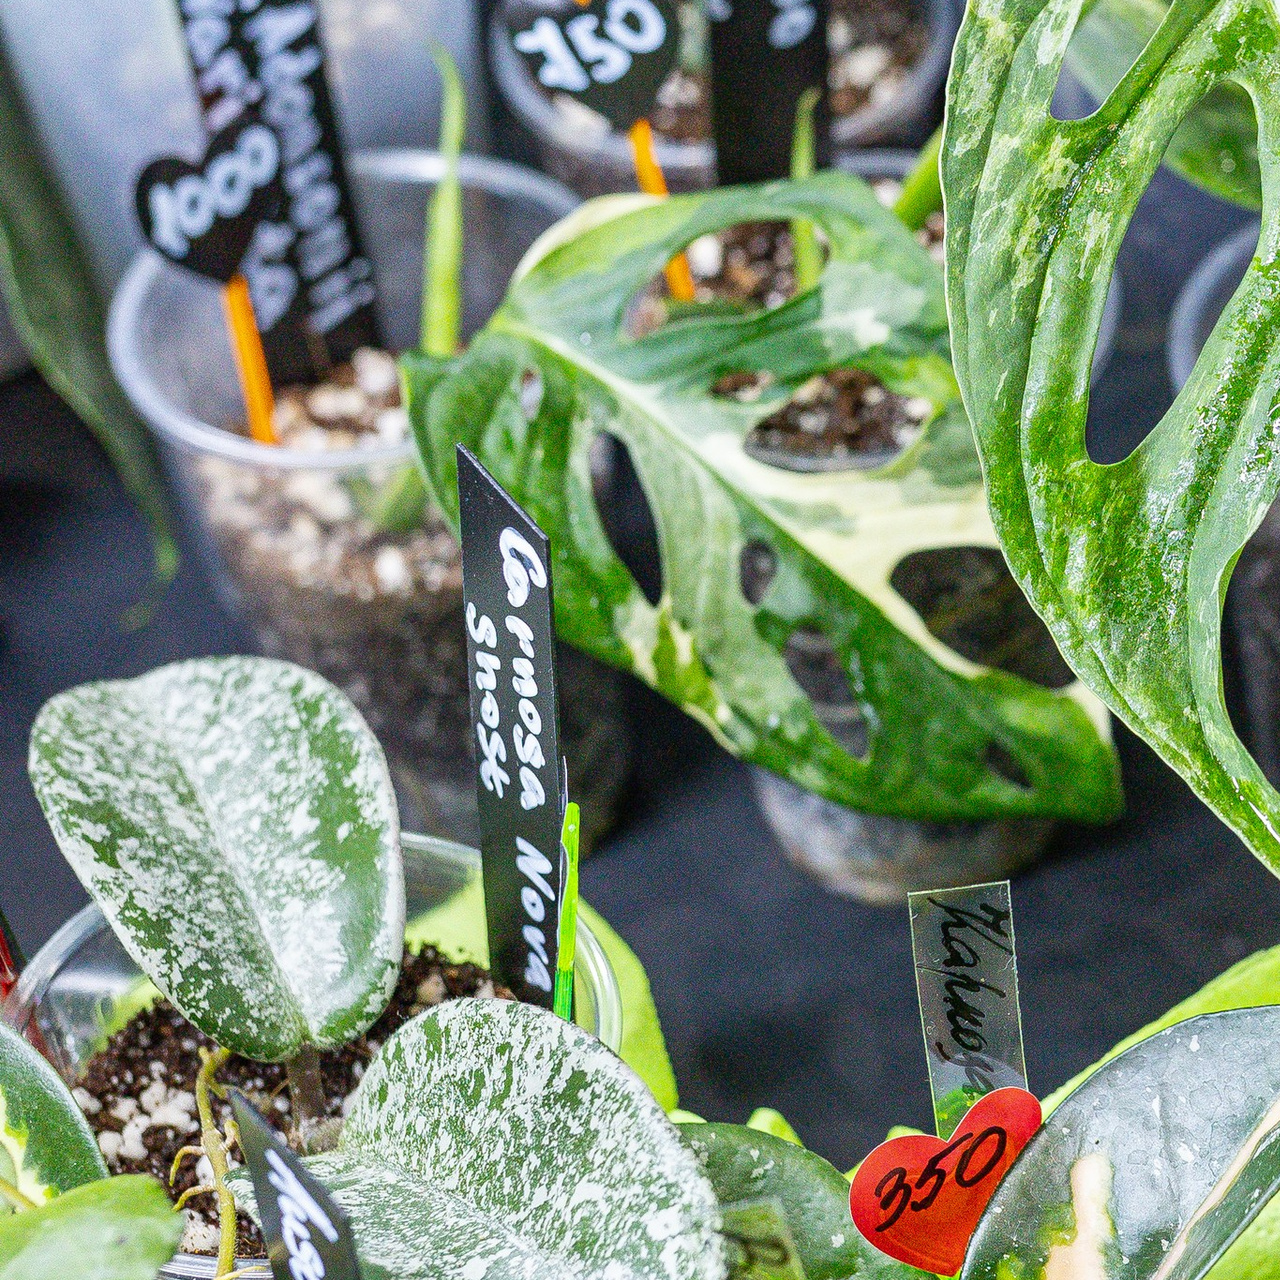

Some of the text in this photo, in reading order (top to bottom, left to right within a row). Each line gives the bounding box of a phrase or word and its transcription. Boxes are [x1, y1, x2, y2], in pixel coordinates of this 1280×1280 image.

[148, 124, 281, 260] 1000
[499, 526, 556, 993] Carnosa Nova
[873, 1124, 1010, 1233] 350
